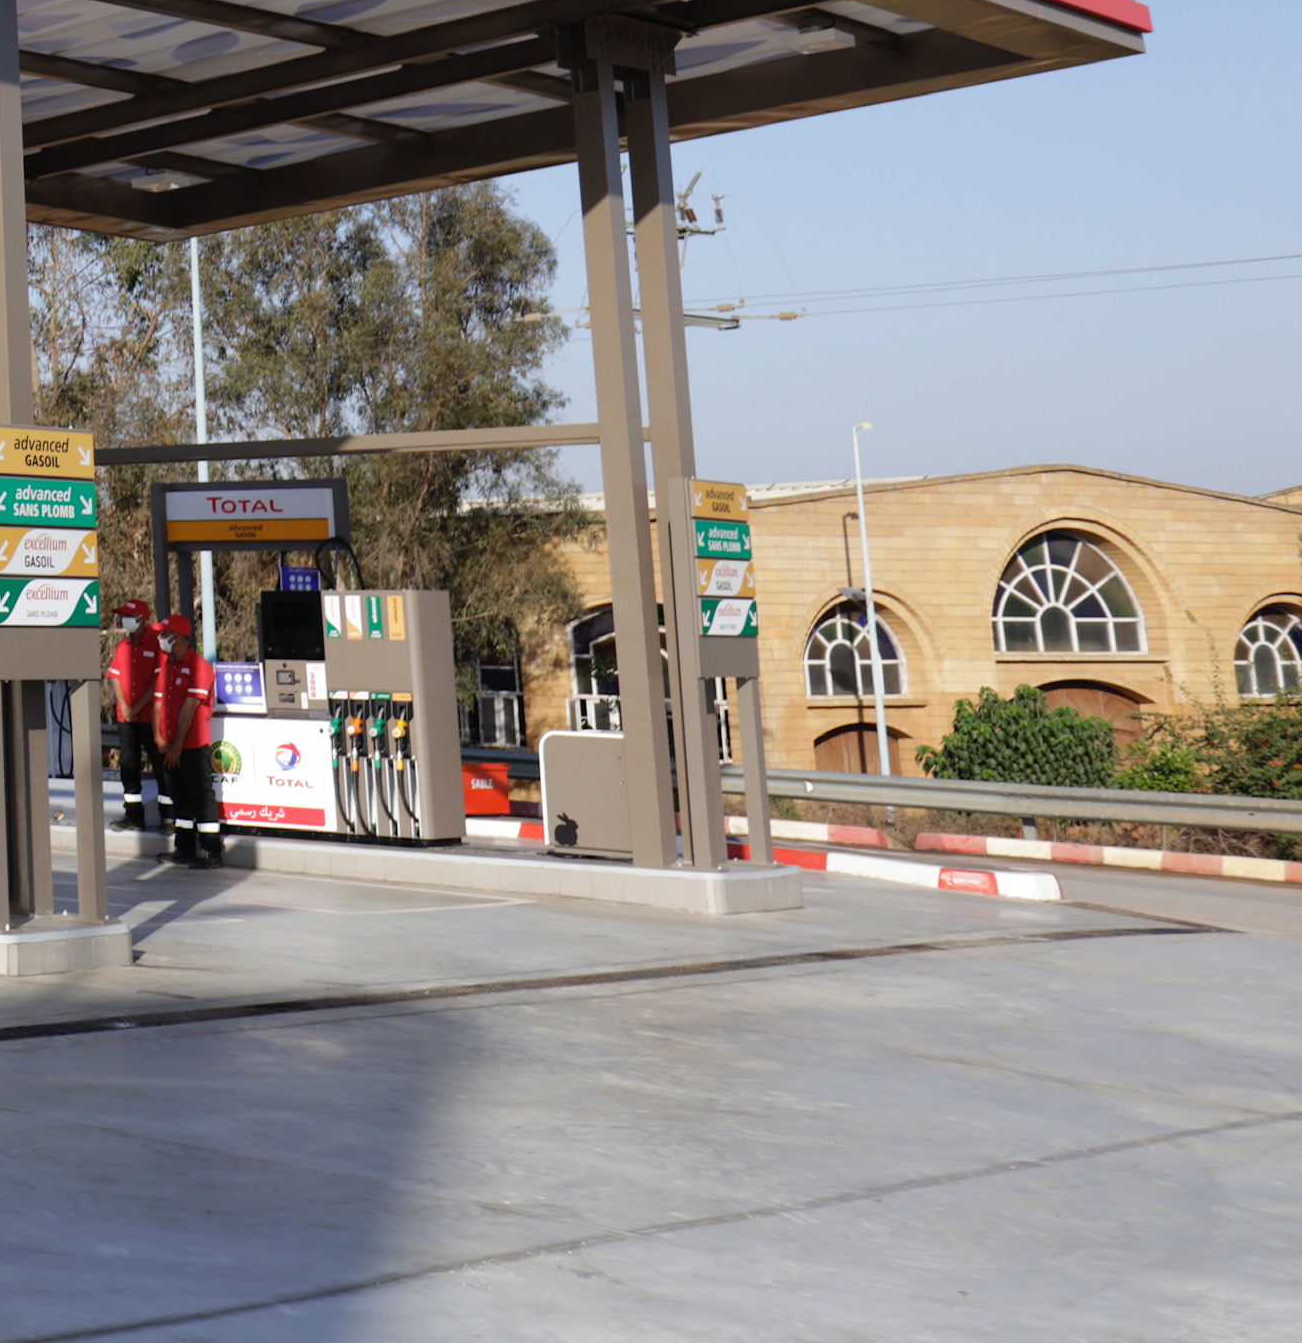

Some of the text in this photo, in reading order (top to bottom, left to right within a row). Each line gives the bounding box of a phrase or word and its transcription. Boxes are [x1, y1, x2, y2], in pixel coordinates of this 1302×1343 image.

[14, 435, 69, 453] advanced
[25, 454, 60, 468] GASOIL
[15, 484, 71, 502] advanced
[706, 488, 734, 501] advanced
[13, 502, 75, 519] SANS PLOMB
[206, 497, 283, 514] TOTAL
[712, 501, 730, 513] GASOIL
[708, 526, 738, 539] advanced
[24, 534, 67, 551] excellium
[708, 540, 741, 553] SANS PLOMB
[24, 555, 54, 568] GASOIL
[26, 584, 68, 601] excellium
[716, 581, 733, 591] GASOIL
[266, 775, 313, 789] TOTAL
[471, 778, 493, 789] SABLE
[229, 805, 285, 821] شريك رسمي
